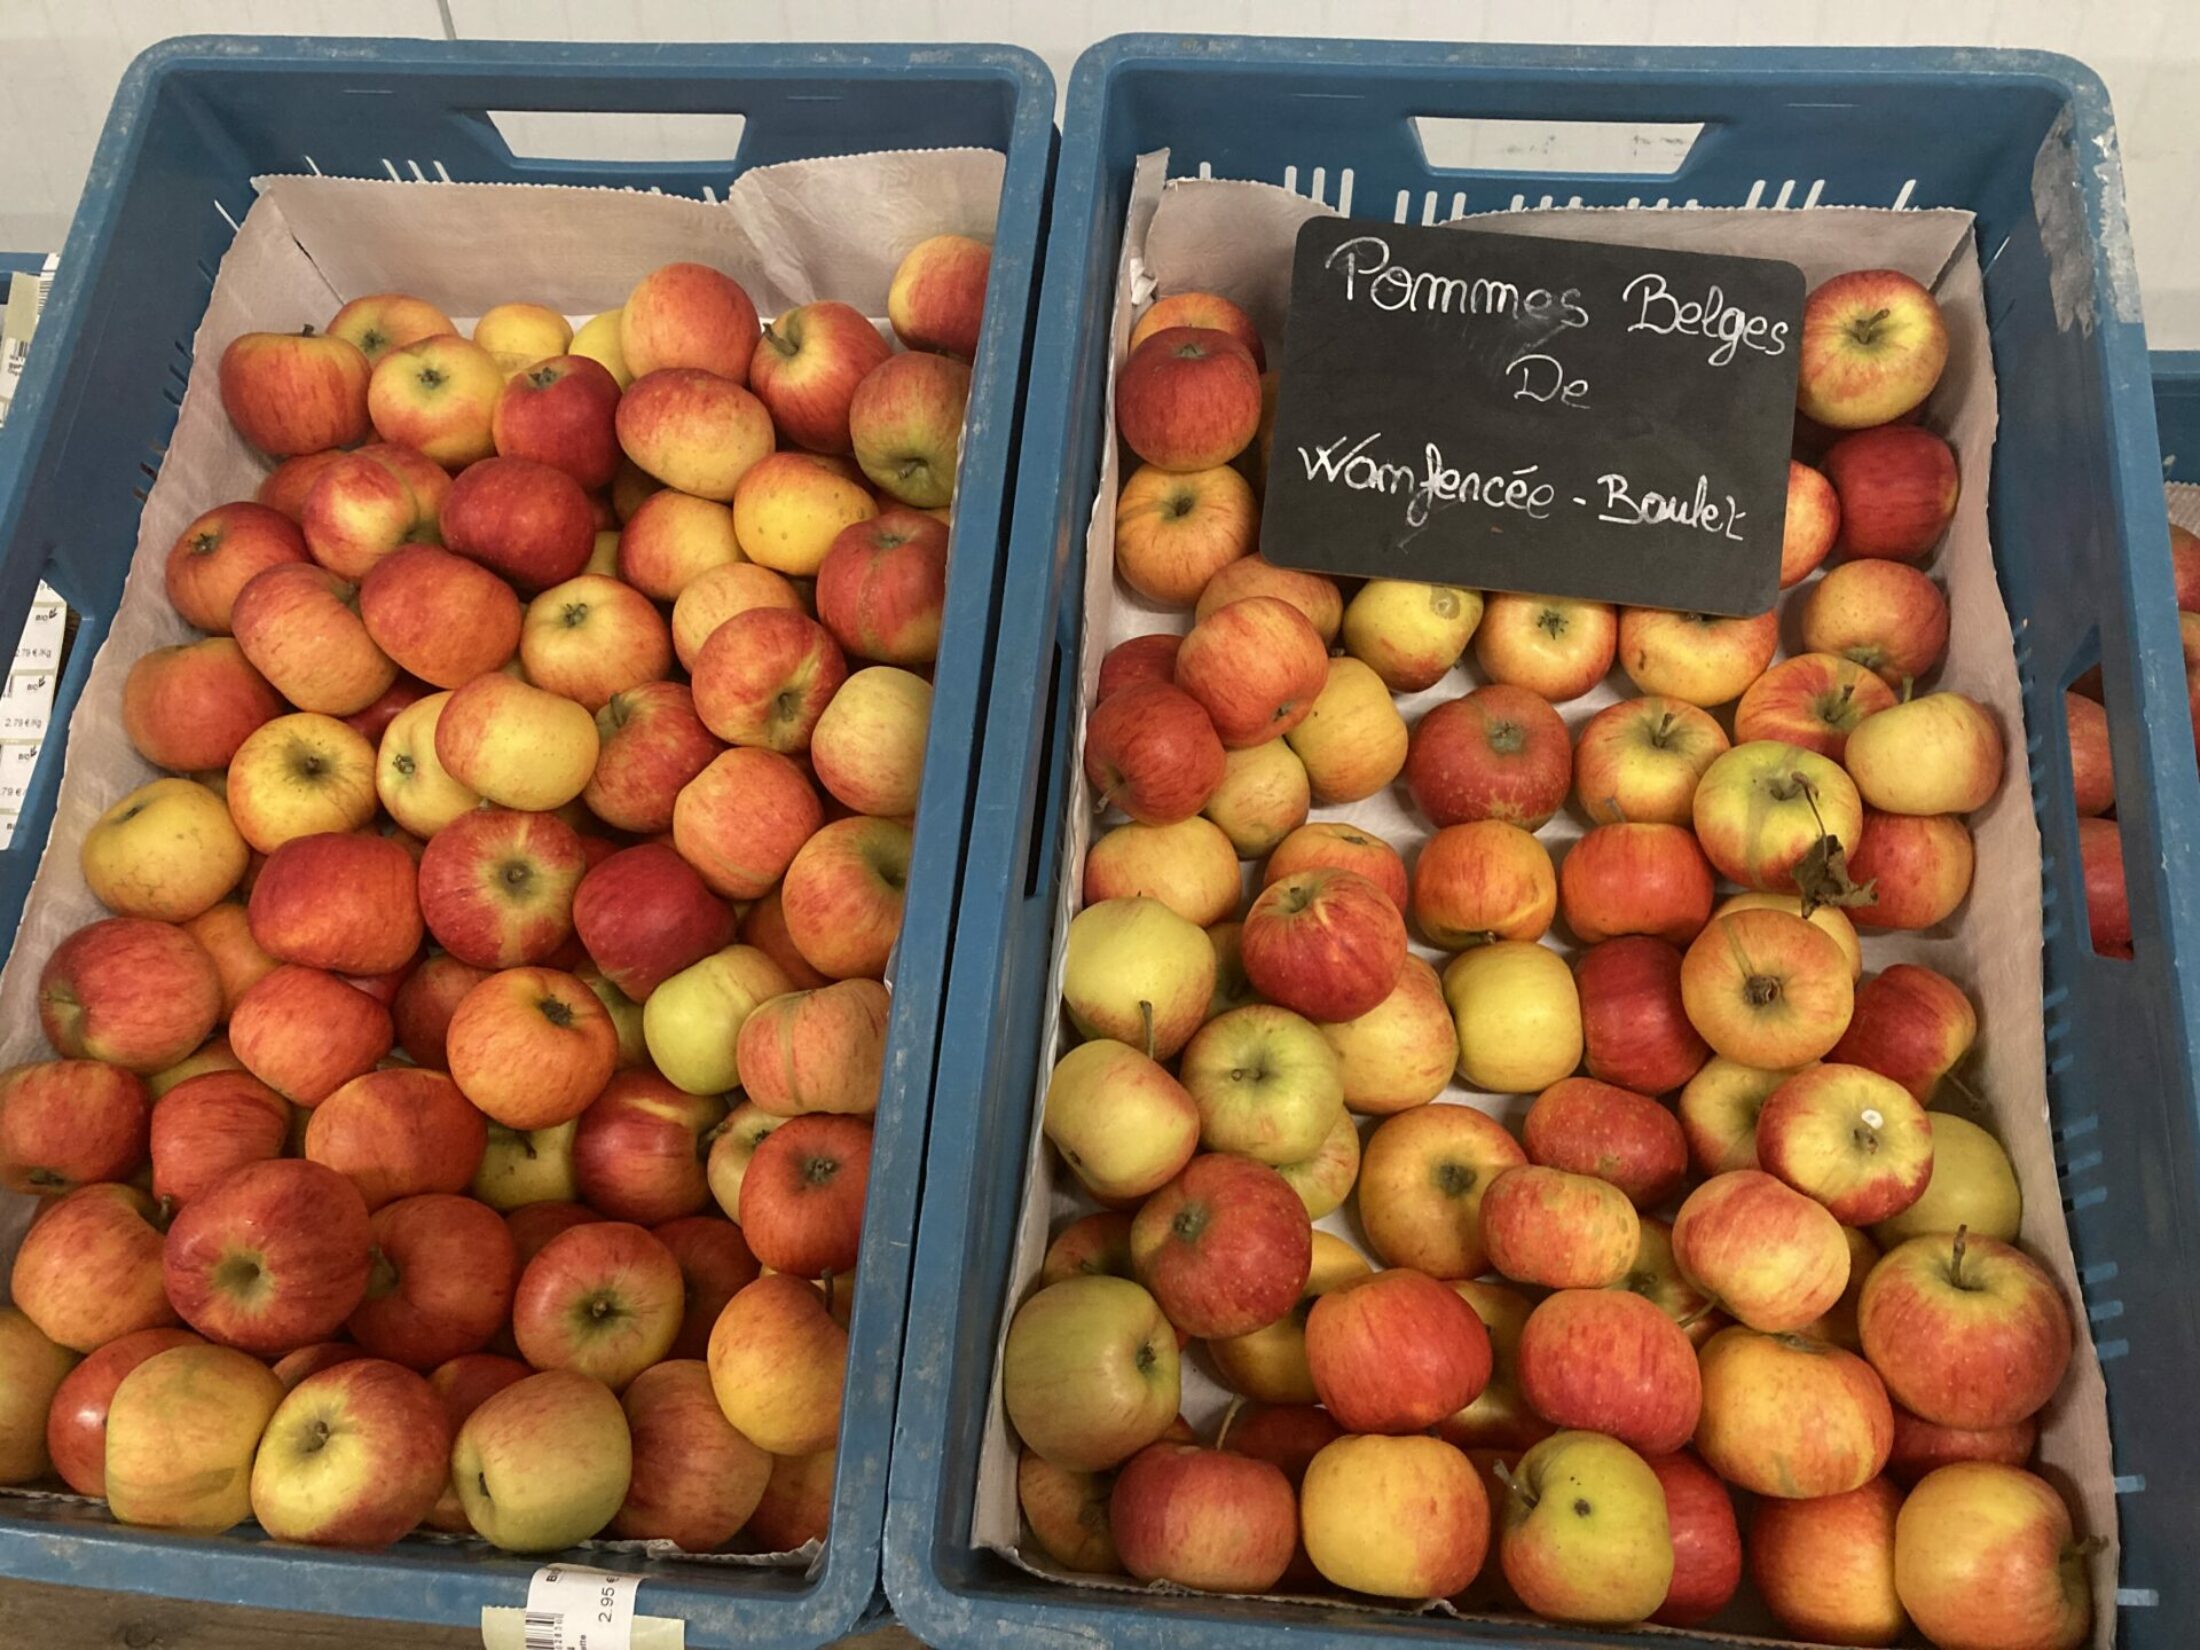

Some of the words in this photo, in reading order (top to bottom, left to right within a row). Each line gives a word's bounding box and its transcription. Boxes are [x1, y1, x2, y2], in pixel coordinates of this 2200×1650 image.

[1324, 236, 1589, 328] Pommes
[1622, 273, 1789, 367] Belges
[1506, 354, 1591, 409] De
[598, 1587, 616, 1623] 2.95
